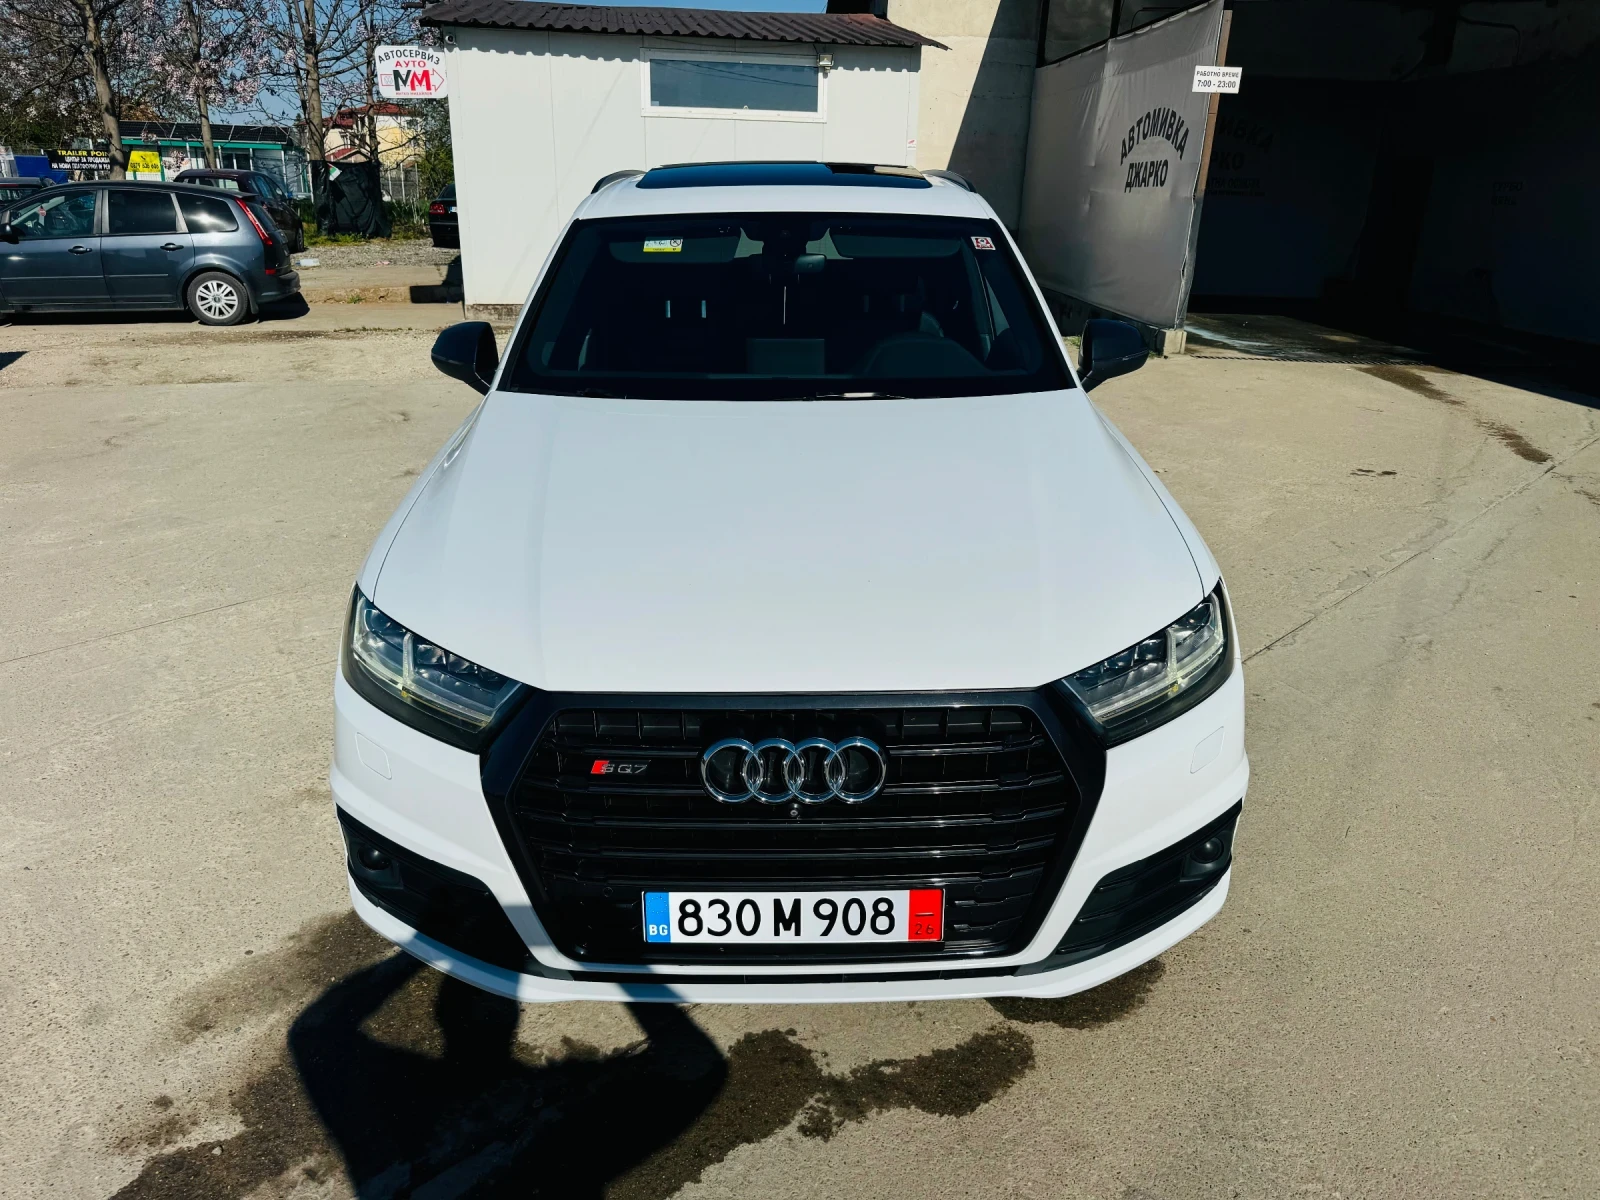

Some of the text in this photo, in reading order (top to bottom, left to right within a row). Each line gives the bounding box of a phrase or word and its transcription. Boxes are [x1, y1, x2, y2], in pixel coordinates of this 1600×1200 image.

[378, 49, 440, 65] АВТОСЕРВИЗ
[395, 60, 426, 68] АУТО
[1197, 79, 1212, 87] 7:00
[1217, 80, 1236, 88] 23:00
[1120, 107, 1190, 166] АВТОМИВКА
[1124, 159, 1169, 193] ДЖАРКО
[649, 897, 935, 937] BG 830 M 908 26
